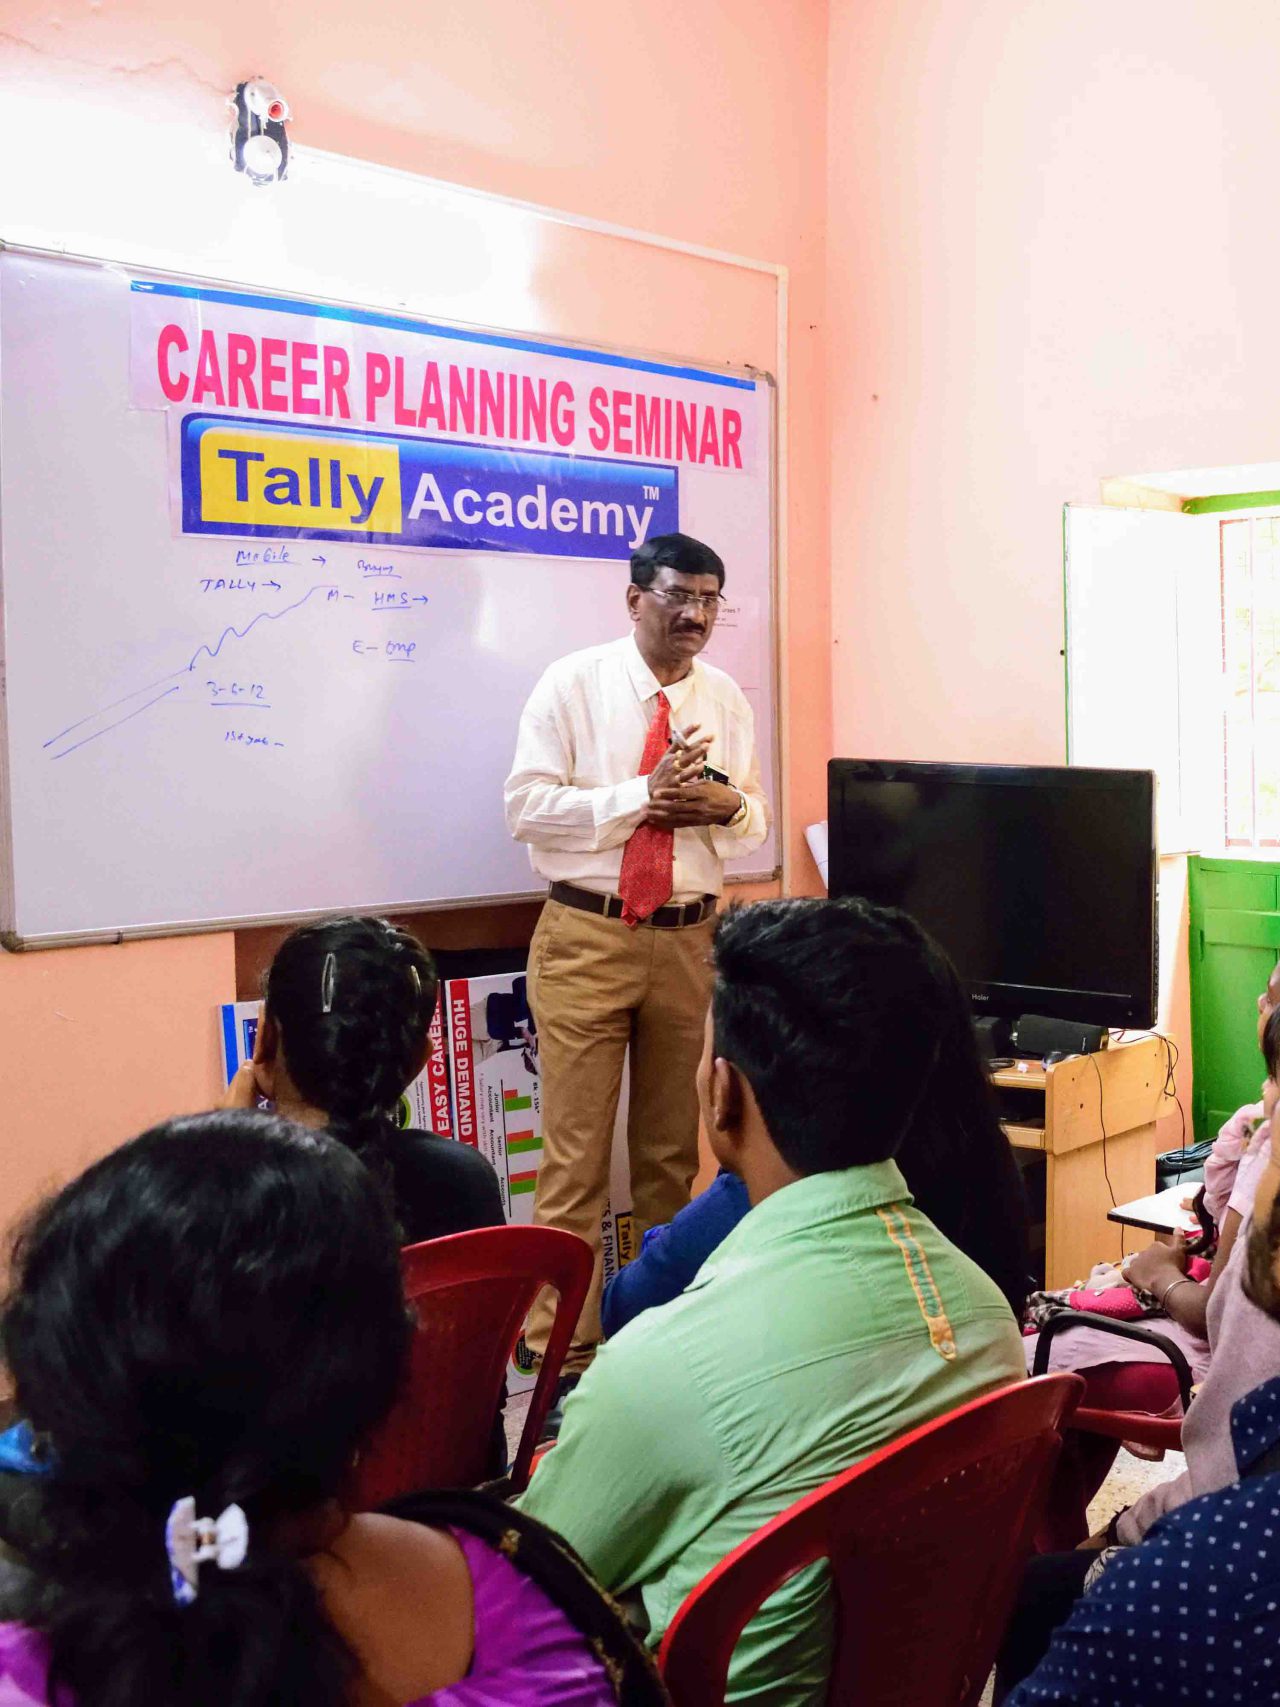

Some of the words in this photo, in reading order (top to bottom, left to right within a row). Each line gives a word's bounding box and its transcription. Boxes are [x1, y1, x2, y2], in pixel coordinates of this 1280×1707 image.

[157, 323, 351, 420] CAREER
[366, 352, 575, 447] PLANNING
[588, 387, 742, 469] SEMINAR
[217, 448, 384, 525] Tally
[408, 473, 653, 549] Academy
[453, 999, 468, 1053] HUGE
[433, 1079, 450, 1132] EASY
[456, 1058, 473, 1136] DEMAND
[620, 1220, 633, 1260] Tally
